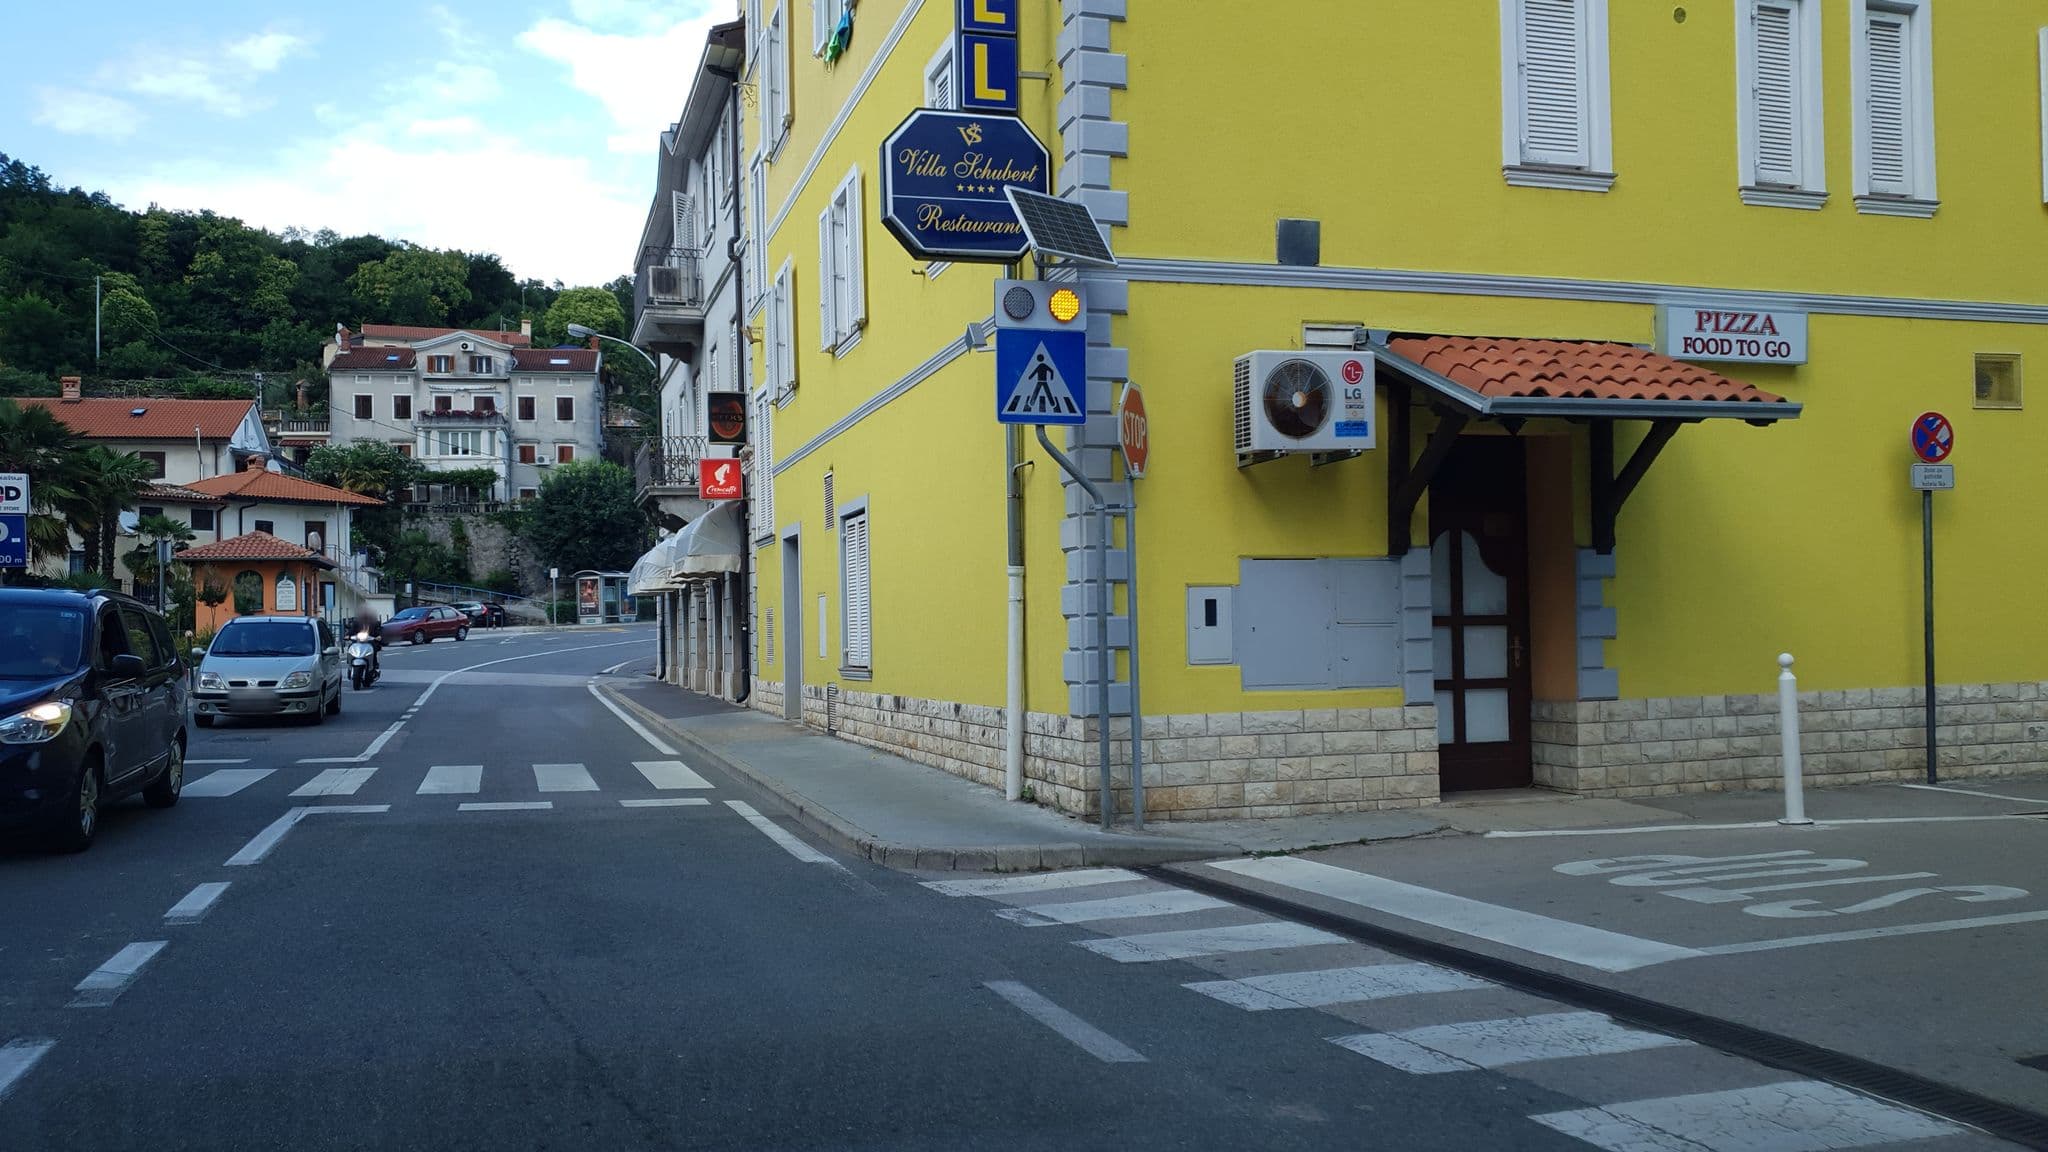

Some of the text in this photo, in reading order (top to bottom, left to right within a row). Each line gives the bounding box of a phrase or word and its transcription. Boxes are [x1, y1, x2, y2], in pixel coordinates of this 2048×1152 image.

[899, 148, 1039, 182] Villa Schubert
[1695, 310, 1779, 336] PIZZA
[1683, 337, 1791, 358] FOOD TO GO
[1344, 388, 1362, 400] LG
[1124, 410, 1146, 449] STOP
